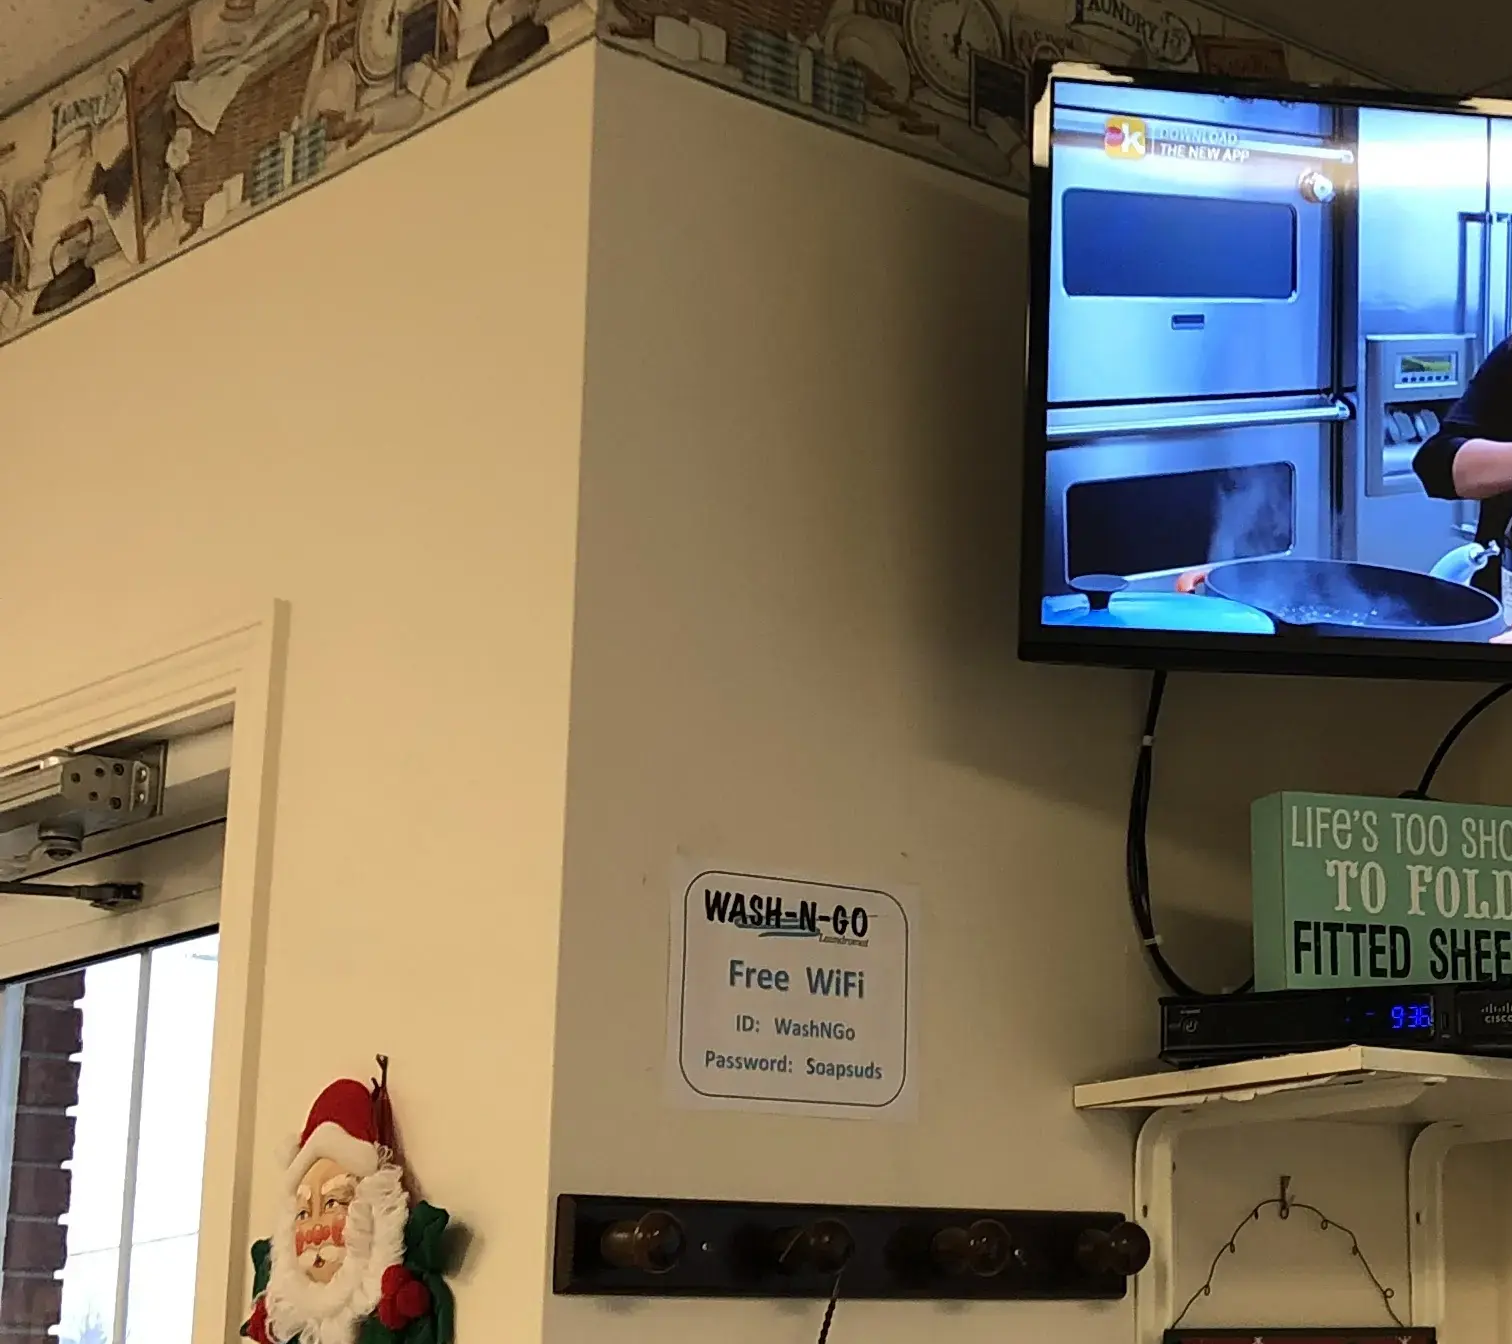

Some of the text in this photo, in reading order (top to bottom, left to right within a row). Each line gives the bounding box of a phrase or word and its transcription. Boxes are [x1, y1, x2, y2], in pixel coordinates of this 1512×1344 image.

[1160, 128, 1239, 146] DOWNLOAD
[1160, 143, 1250, 163] THE NEW APP
[1391, 811, 1449, 857] TOO
[1325, 859, 1388, 915] TO
[704, 888, 869, 938] WASH-N-GO
[1293, 920, 1412, 980] FITTED
[729, 959, 865, 1000] Free WiFi
[736, 1014, 856, 1041] ID: WashNGo
[704, 1050, 883, 1081] Password: Soapsuds
